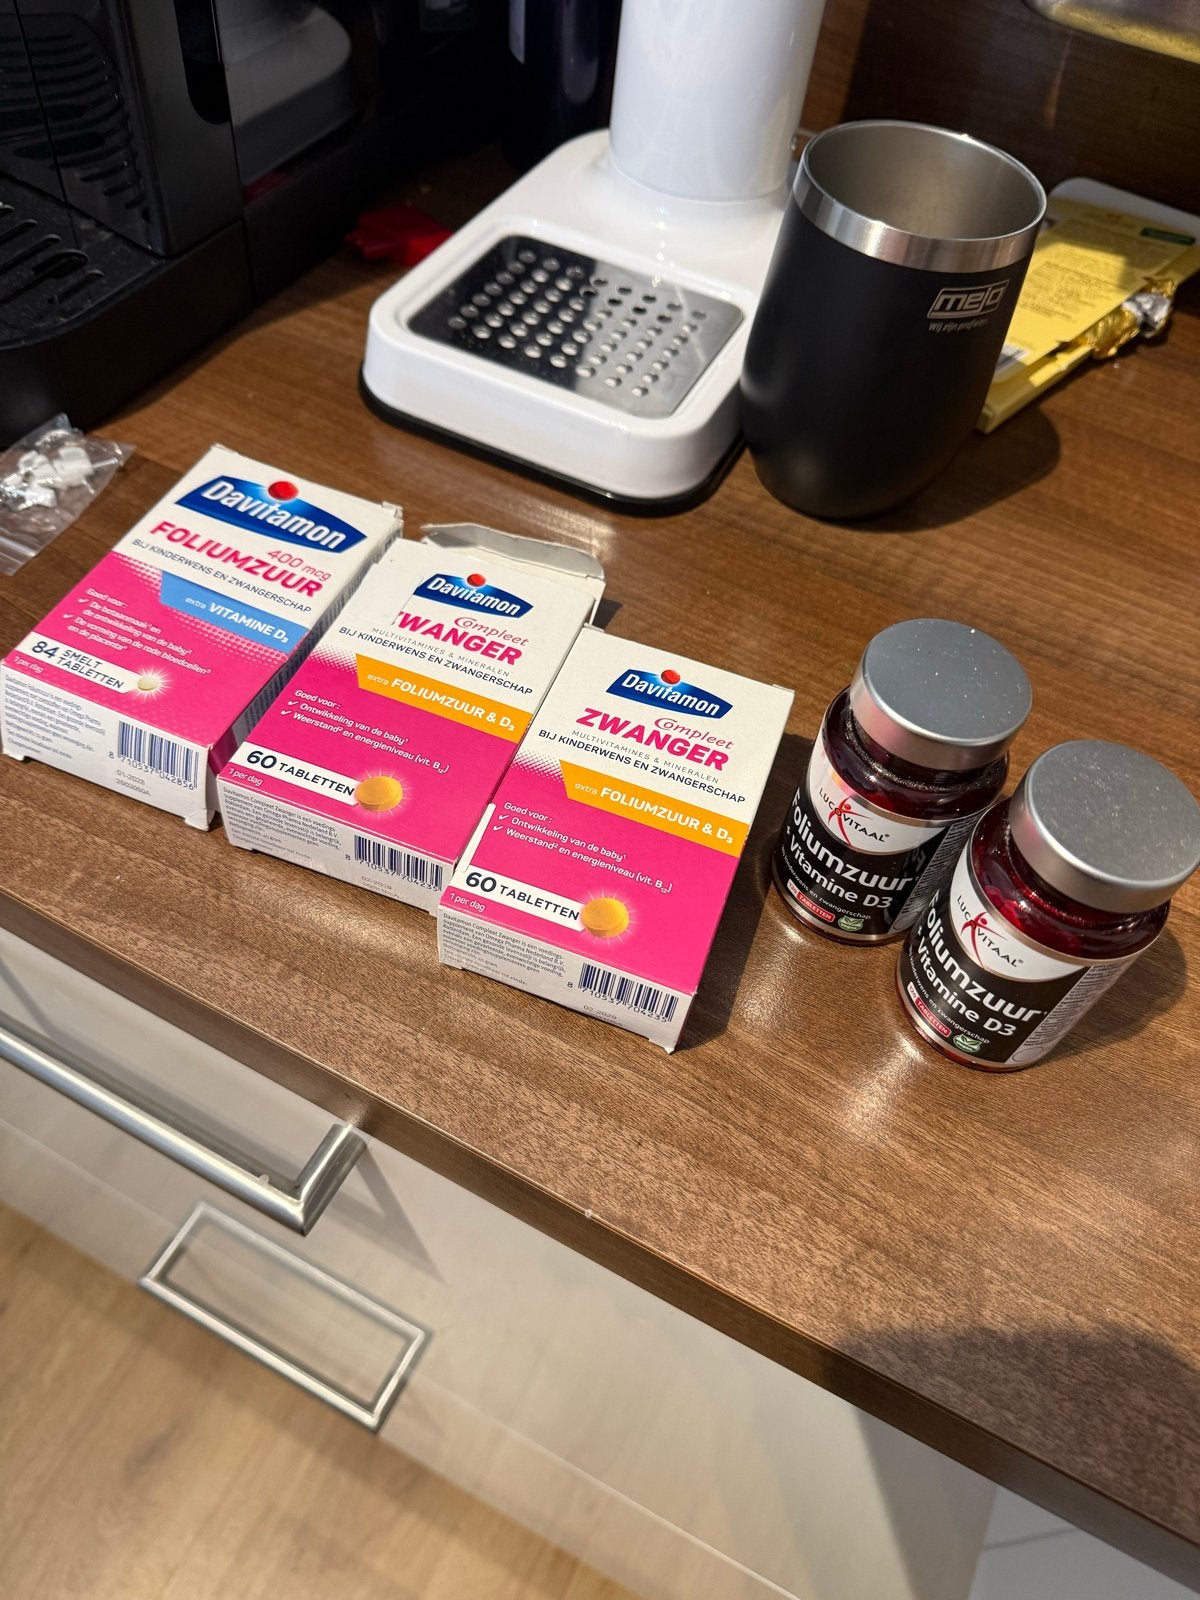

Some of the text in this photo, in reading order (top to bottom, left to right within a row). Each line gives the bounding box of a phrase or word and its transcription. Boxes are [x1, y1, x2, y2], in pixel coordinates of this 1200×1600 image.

[201, 481, 346, 549] Davitamon
[133, 539, 312, 613] BIJ KINDERWENS EN ZWANGERSCHAP
[149, 521, 324, 598] FOLIUMZUUR
[267, 551, 332, 582] 400 mcg
[427, 577, 521, 616] Davitamon
[185, 597, 206, 609] extra
[209, 602, 274, 636] VITAMINE
[454, 617, 529, 647] Compleet
[32, 641, 60, 658] 84
[117, 632, 132, 642] van
[132, 638, 143, 648] de
[143, 642, 161, 655] rode
[142, 630, 155, 640] van
[156, 635, 166, 644] de
[371, 628, 445, 654] MULTIVITAMINES
[457, 655, 510, 676] MINERALEN
[400, 611, 523, 666] WANGER
[18, 659, 30, 669] per
[29, 661, 44, 674] dag
[56, 657, 125, 689] TABLETTEN
[63, 649, 103, 668] SMELT
[339, 627, 533, 695] BIJ KINDERWENS EN ZWANGERSCHAP
[295, 690, 317, 702] Goed
[367, 673, 389, 685] extra
[391, 678, 486, 719] FOLIUMZUUR
[486, 712, 497, 723] &
[622, 673, 720, 716] Davitamon
[300, 703, 354, 728] Ontwikkeling
[356, 720, 370, 730] van
[371, 725, 382, 735] de
[654, 717, 734, 749] Compleet
[109, 751, 114, 759] 8
[342, 729, 354, 738] en
[355, 733, 414, 760] energieniveau
[571, 730, 649, 760] MULTIVITAMINES
[664, 761, 719, 784] MINERALEN
[576, 708, 729, 771] ZWANGER
[233, 770, 248, 782] per
[247, 775, 263, 786] dag
[246, 750, 355, 796] 60 TABLETTEN
[538, 730, 745, 804] BIJ KINDERWENS EN ZWANGERSCHAP
[504, 802, 528, 815] Goed
[574, 782, 598, 795] extra
[600, 787, 700, 831] FOLIUMZUUR
[702, 823, 713, 835] &
[511, 817, 569, 843] Ontwikkeling
[570, 836, 586, 848] van
[587, 841, 600, 852] de
[559, 846, 570, 855] en
[572, 849, 635, 879] energieniveau
[790, 834, 858, 903] Vitamine
[863, 894, 893, 908] D3
[455, 895, 470, 907] per
[470, 899, 486, 913] dag
[465, 872, 580, 920] 60 TABLETTEN
[918, 936, 979, 1023] Vitamine
[983, 1018, 1016, 1036] D3
[917, 999, 949, 1034] TABLETTEN
[938, 1007, 990, 1044] zwangerschap
